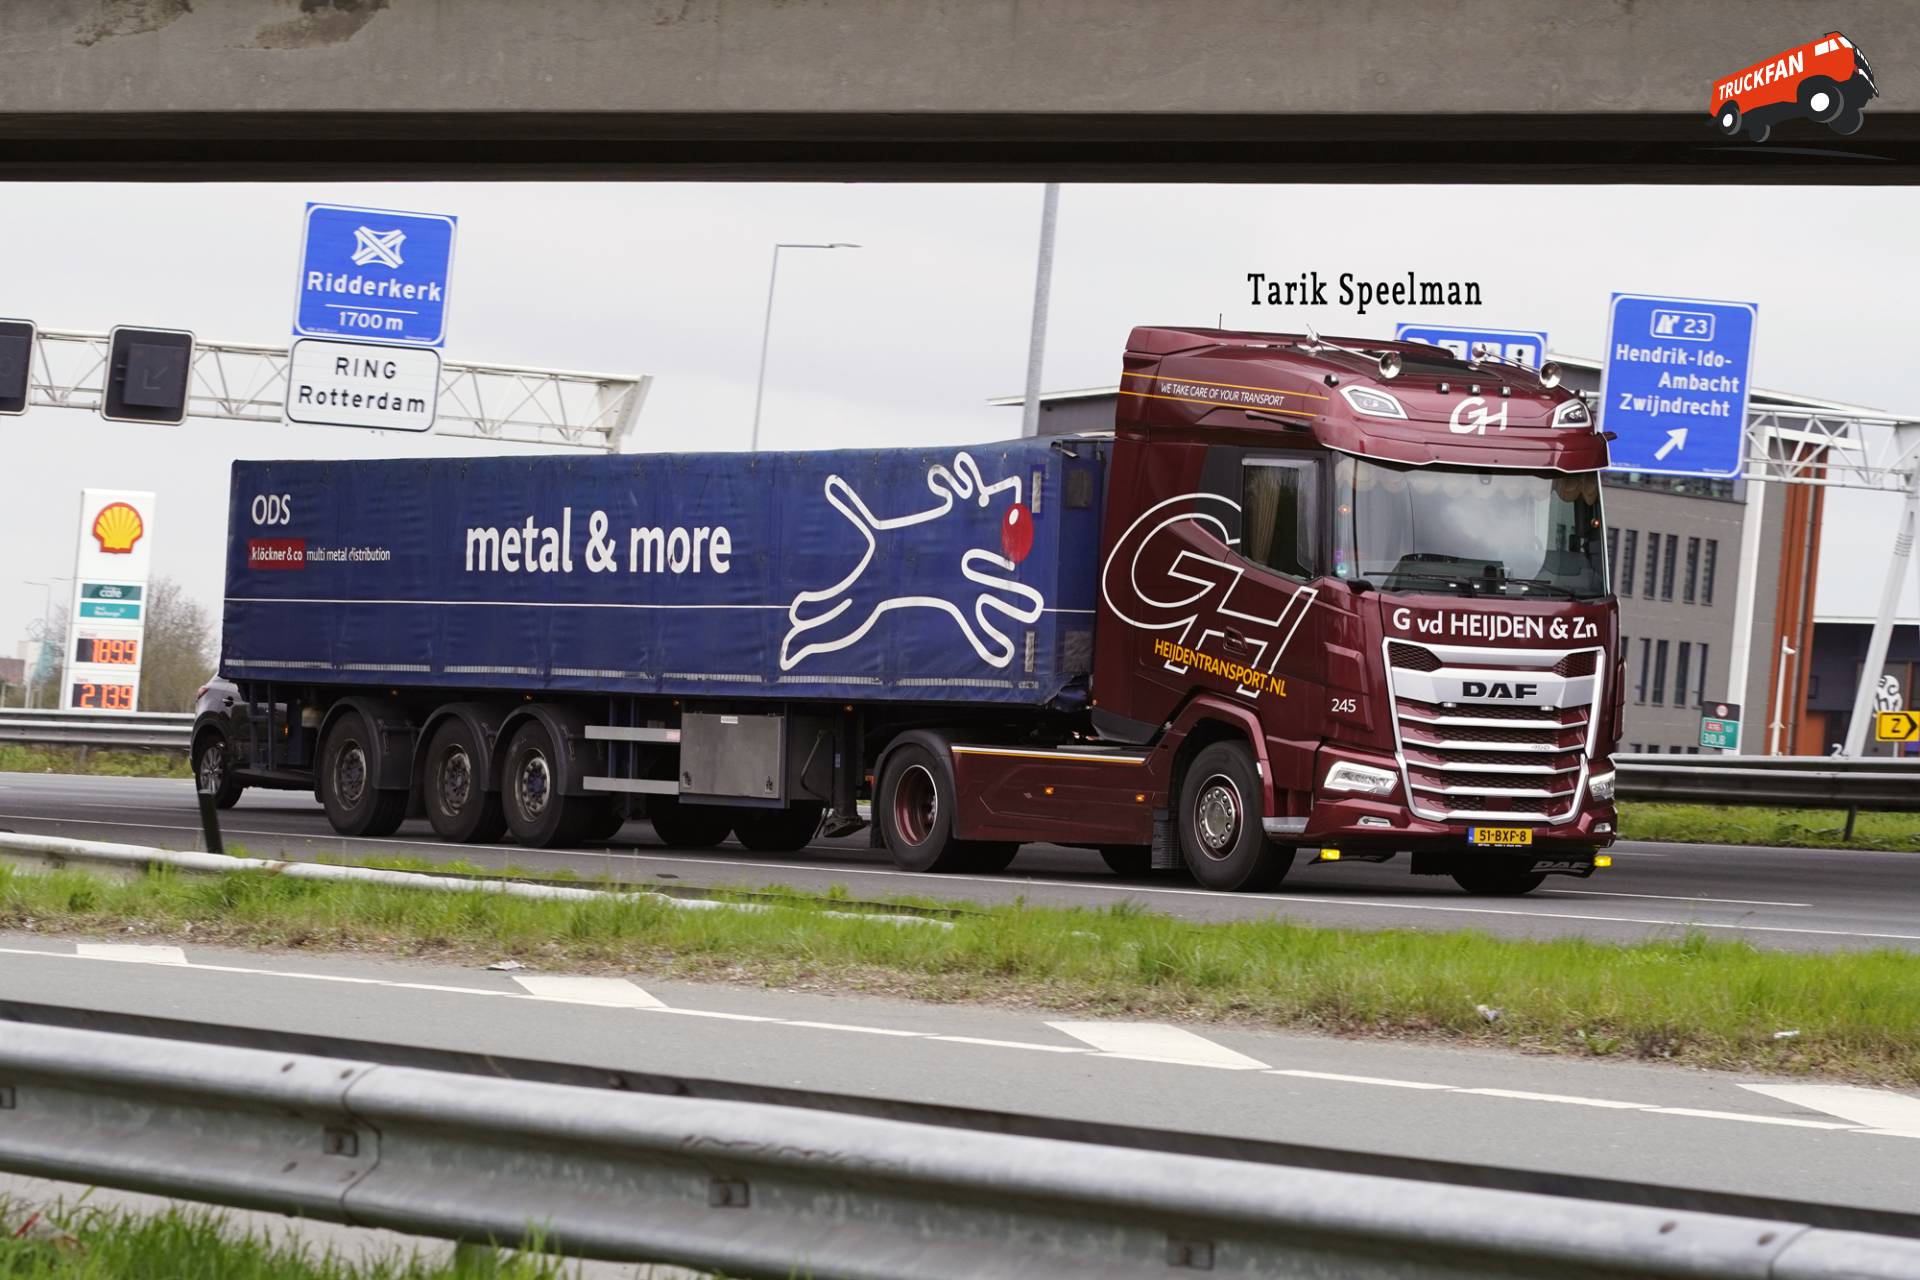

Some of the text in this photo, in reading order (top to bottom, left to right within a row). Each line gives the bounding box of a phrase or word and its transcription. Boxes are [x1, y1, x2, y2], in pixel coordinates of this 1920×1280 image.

[307, 271, 442, 301] Ridderkerk
[339, 311, 403, 331] 1700 m
[1683, 318, 1708, 334] 23
[1615, 344, 1732, 368] Hendrik-Ido-
[335, 357, 397, 379] RING
[1657, 371, 1740, 394] Ambacht
[299, 385, 425, 413] Rotterdam
[1161, 383, 1285, 406] WE TAKE CARE OF YOUR TRANSPORT
[1618, 393, 1731, 417] Zwijndrecht
[1449, 396, 1508, 435] GH
[251, 494, 291, 525] ODS
[465, 507, 732, 574] metal & more
[306, 547, 391, 562] multi metal distribution
[1393, 608, 1598, 641] G vd HEIJDEN & Zn
[1154, 638, 1287, 697] HEIJDENTRANSPORT.NL
[1462, 681, 1537, 699] DAF
[1331, 698, 1357, 713] 245
[1479, 830, 1527, 842] 51-BXF-8
[1533, 860, 1591, 869] DAF
